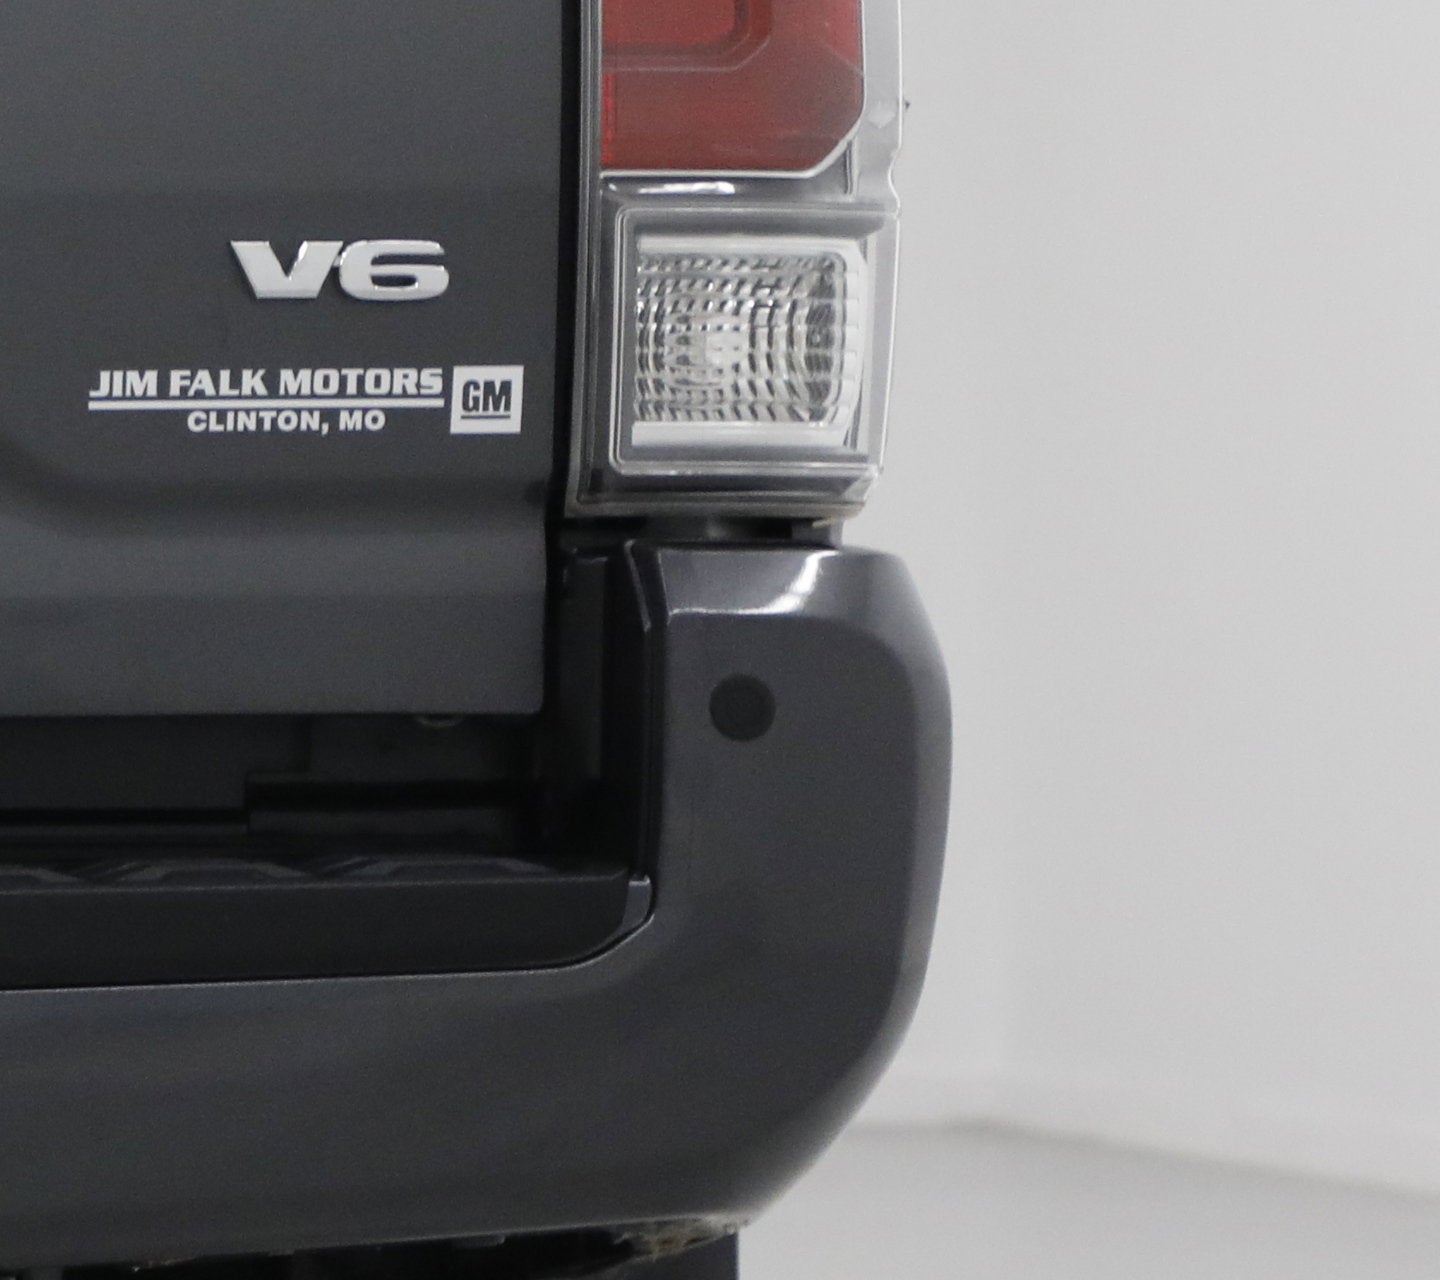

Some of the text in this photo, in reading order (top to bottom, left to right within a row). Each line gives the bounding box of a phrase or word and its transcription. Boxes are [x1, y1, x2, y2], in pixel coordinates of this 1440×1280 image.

[230, 239, 450, 302] V6
[88, 367, 444, 399] JIM FALK MOTORS
[461, 379, 512, 414] GM
[186, 410, 386, 436] CLINTON, MO
